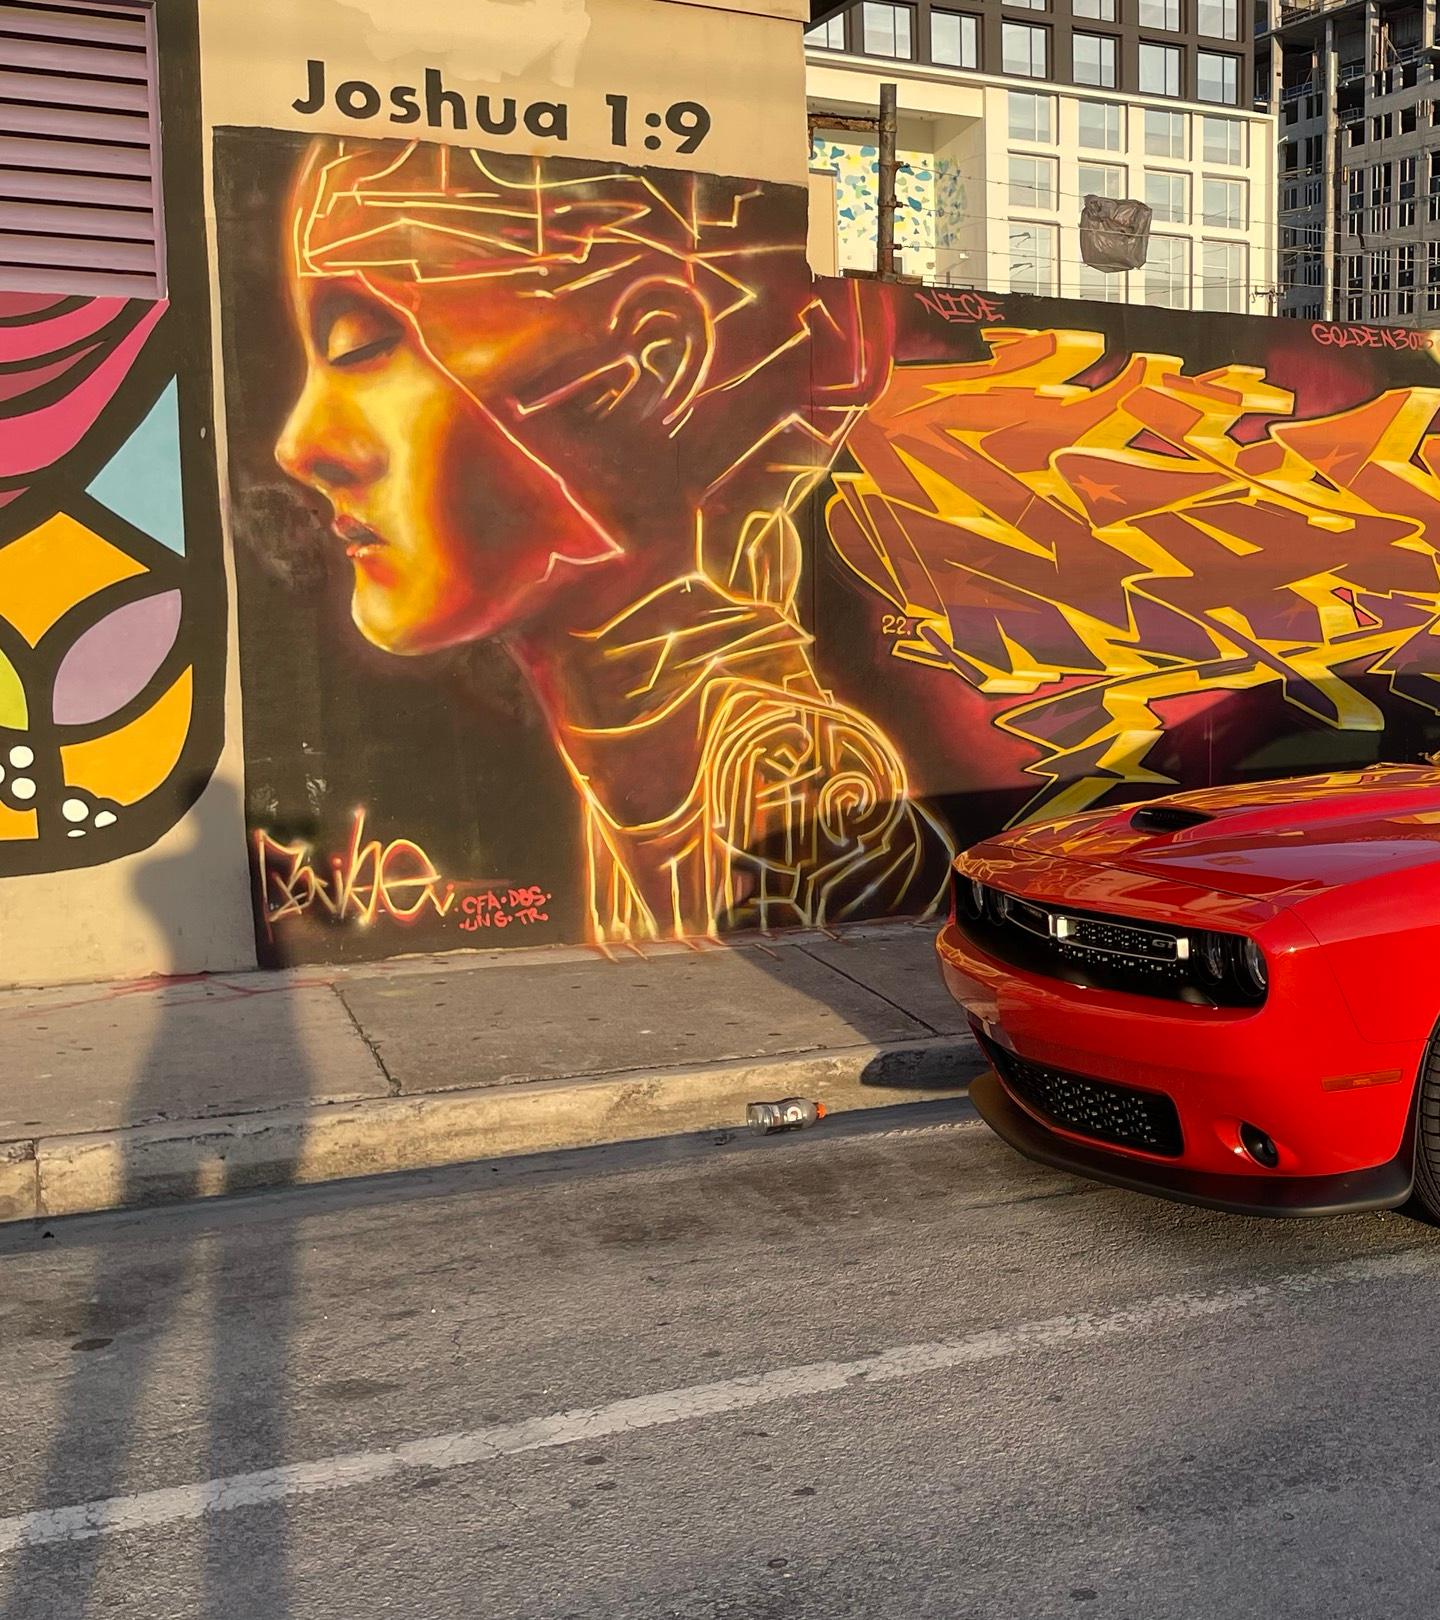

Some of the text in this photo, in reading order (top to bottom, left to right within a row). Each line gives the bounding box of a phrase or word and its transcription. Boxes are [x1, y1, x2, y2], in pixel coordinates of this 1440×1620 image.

[292, 59, 711, 154] Joshua 1:9
[914, 289, 1005, 324] NICE
[1152, 939, 1176, 949] GT
